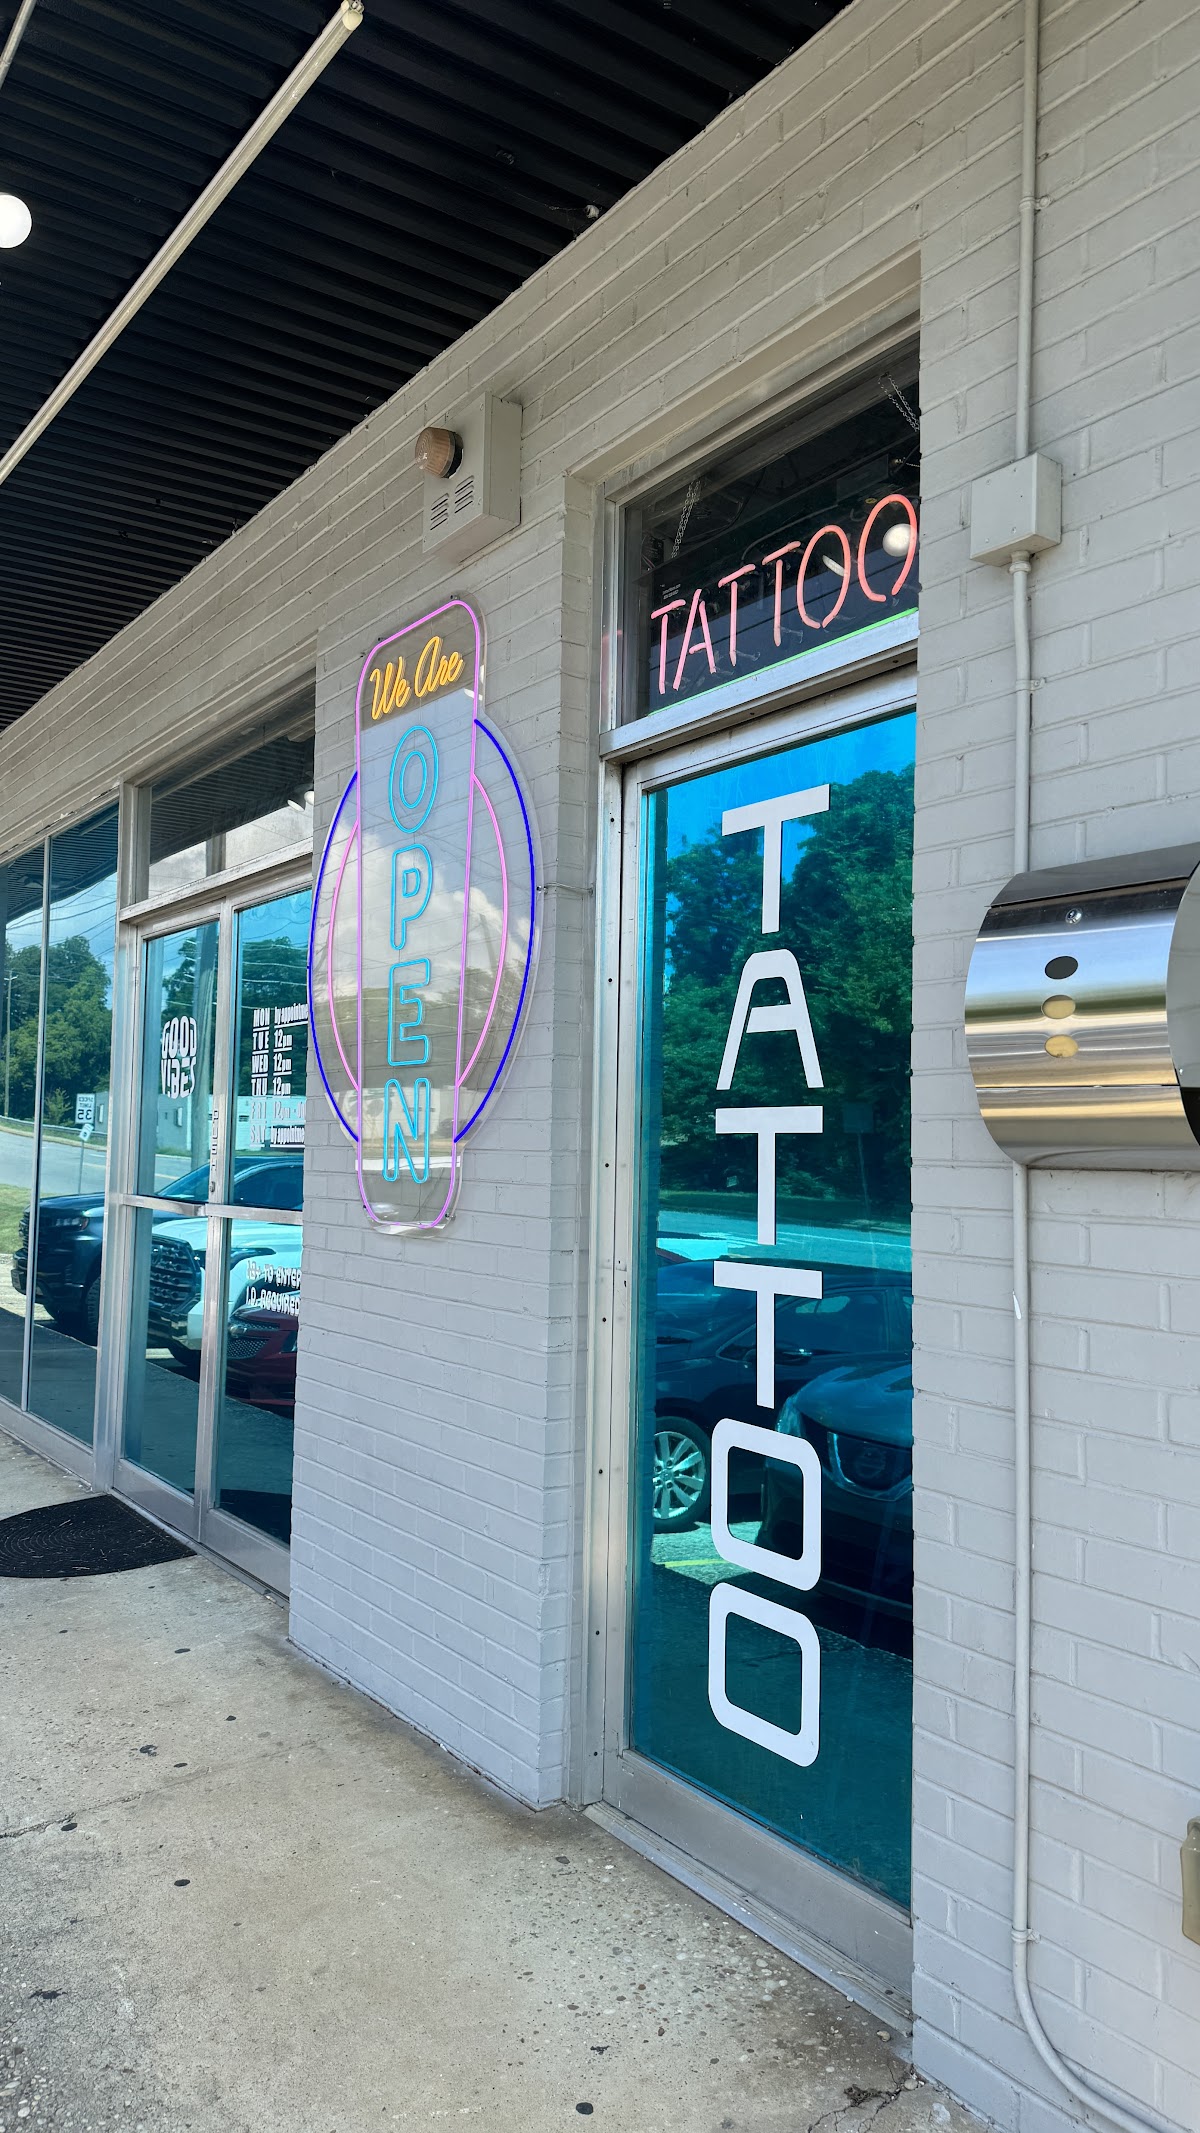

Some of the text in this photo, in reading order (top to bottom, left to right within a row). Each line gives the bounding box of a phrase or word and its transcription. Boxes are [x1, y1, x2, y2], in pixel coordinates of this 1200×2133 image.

[651, 494, 917, 695] TATTOO
[369, 636, 464, 720] We Are
[383, 725, 438, 1184] OPEN
[253, 1007, 270, 1027] MON
[274, 1006, 281, 1025] by
[161, 1015, 197, 1059] GOOD
[252, 1029, 293, 1050] TUE 12pm
[251, 1052, 292, 1073] WED 12pm
[251, 1077, 291, 1096] THU 12pm
[251, 1101, 267, 1119] FRI
[273, 1101, 291, 1120] 12pm
[250, 1124, 266, 1143] SAT
[271, 1126, 278, 1144] by
[264, 1264, 274, 1284] TO
[708, 783, 831, 1768] TATTOO
